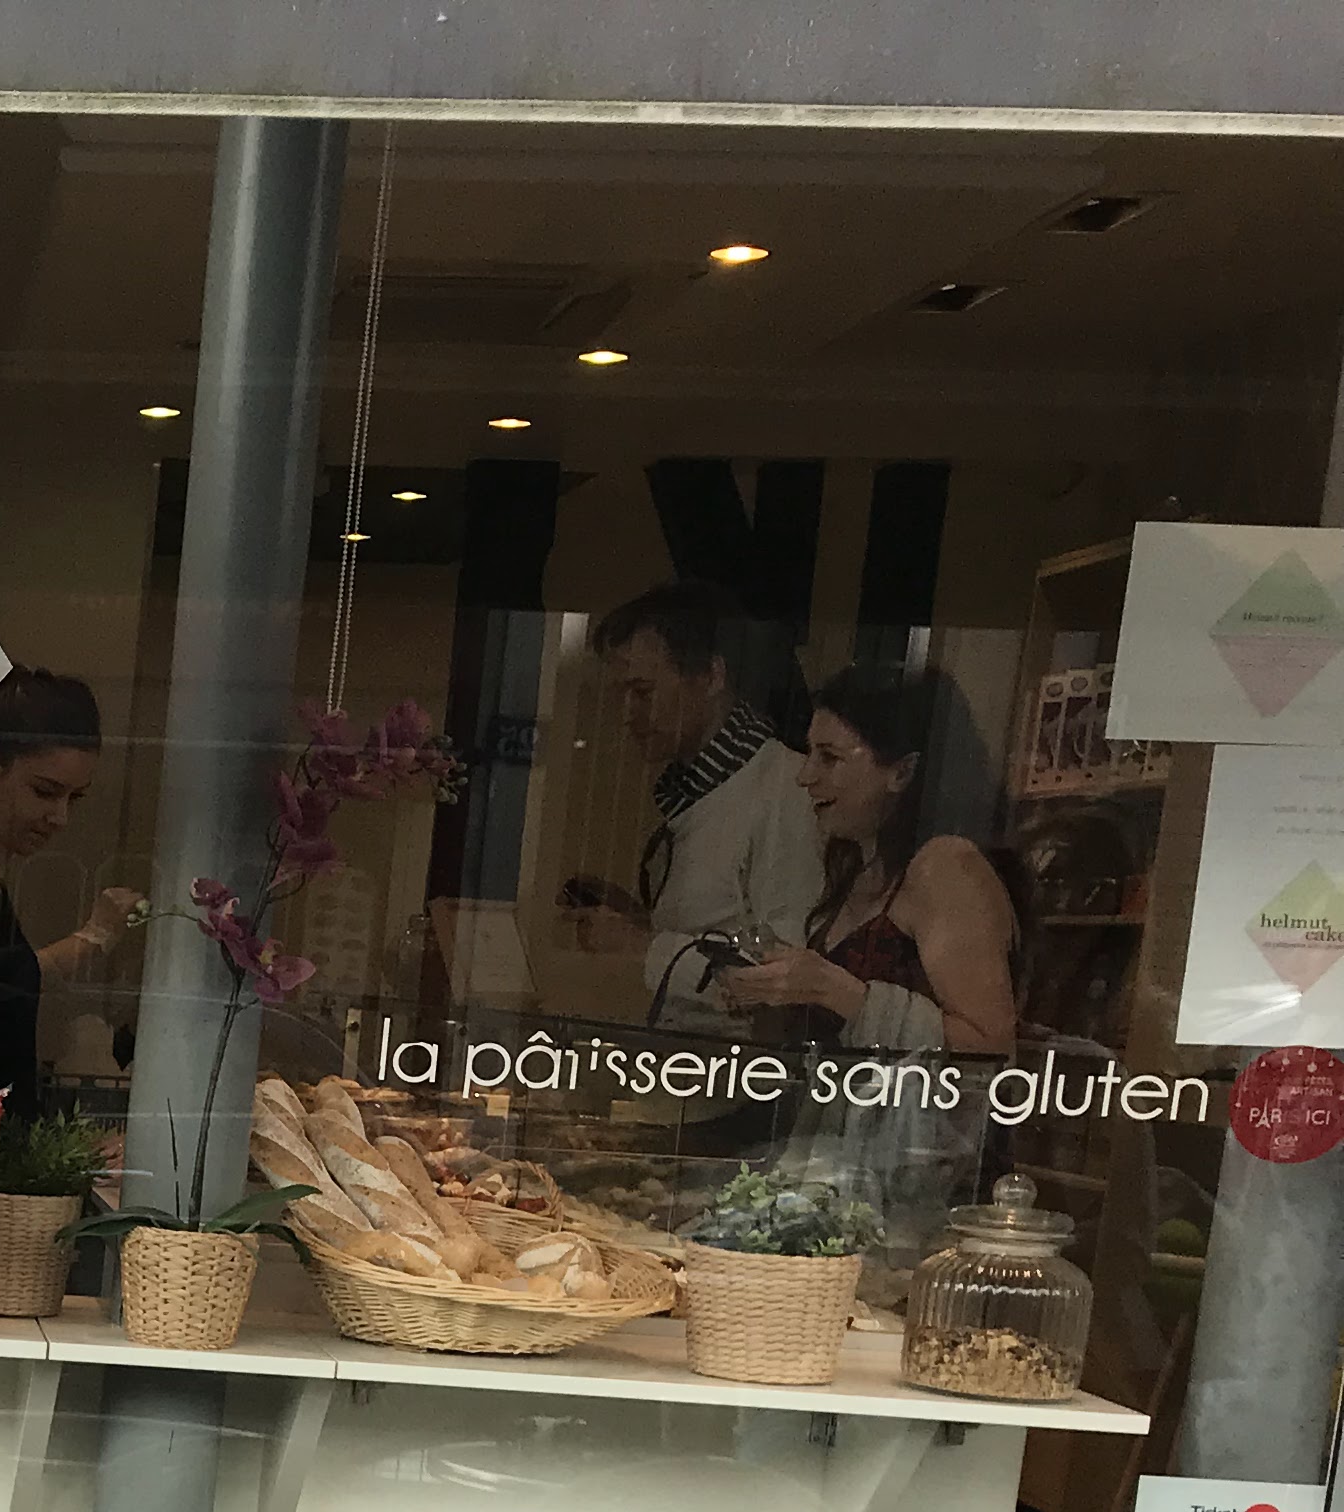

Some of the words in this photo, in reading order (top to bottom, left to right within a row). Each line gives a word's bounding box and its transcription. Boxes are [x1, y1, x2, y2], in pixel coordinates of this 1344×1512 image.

[378, 1017, 439, 1083] la
[811, 1060, 962, 1109] sans
[989, 1050, 1210, 1126] gluten
